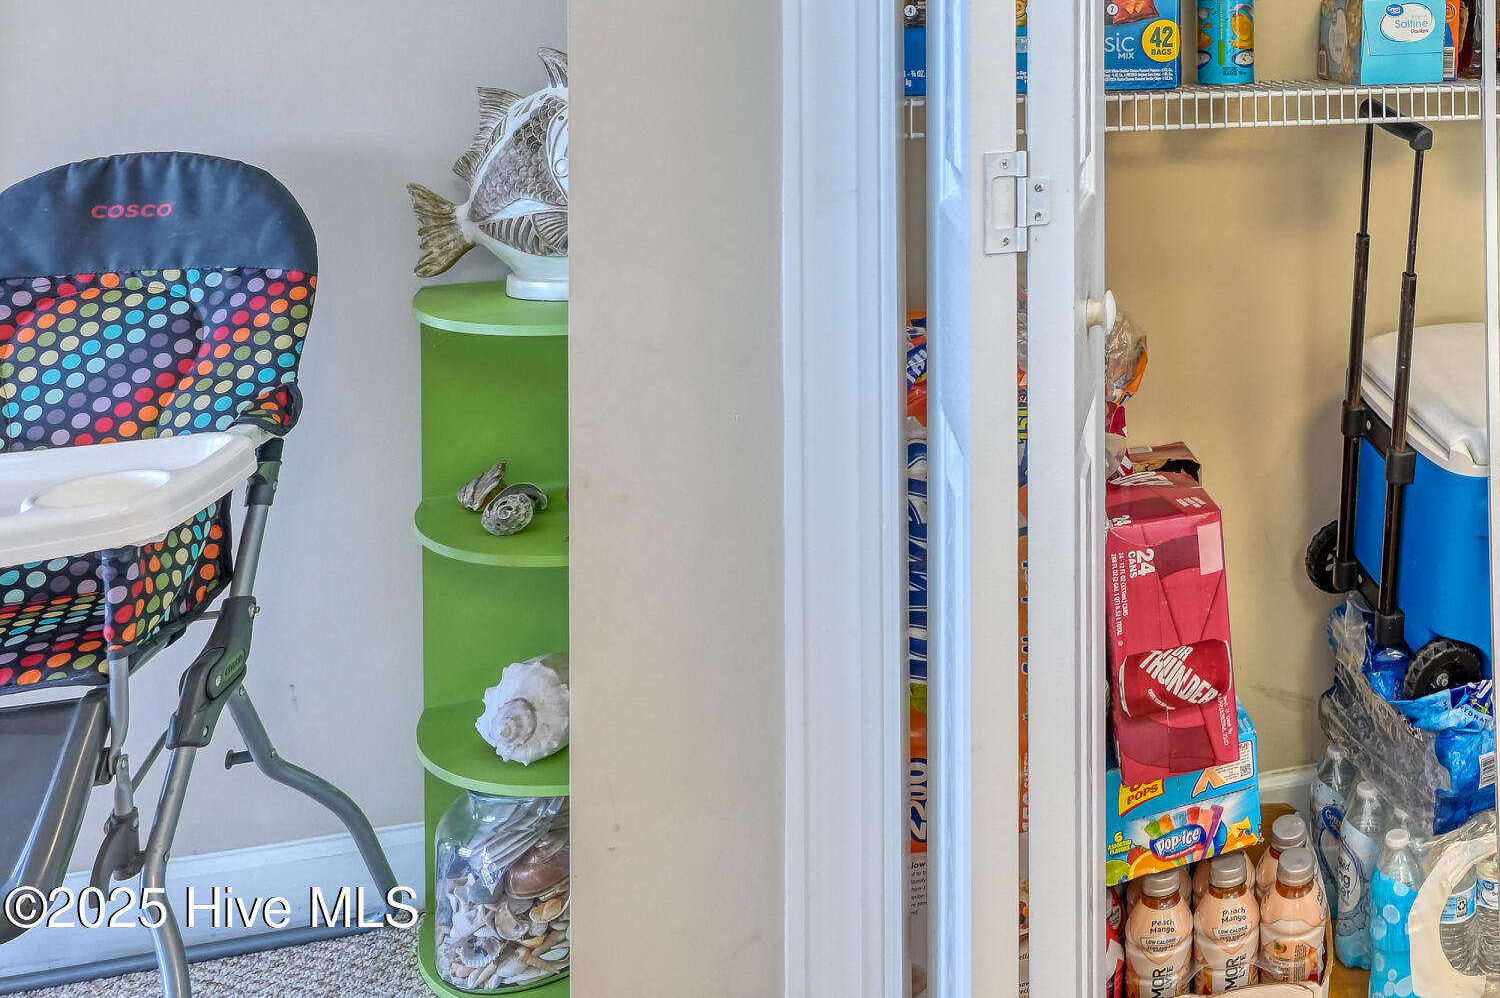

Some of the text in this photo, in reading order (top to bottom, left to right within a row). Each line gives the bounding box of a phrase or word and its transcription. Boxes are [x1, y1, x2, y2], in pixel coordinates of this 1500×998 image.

[1395, 19, 1428, 29] Saltine
[1104, 32, 1134, 52] sic
[1150, 26, 1173, 47] 42
[91, 203, 172, 218] COSCO
[1128, 551, 1137, 579] CANS
[1136, 548, 1156, 579] 24
[1172, 646, 1193, 661] DR
[1140, 650, 1219, 704] THUNDER
[1127, 783, 1159, 805] POPS
[1114, 832, 1123, 842] 6
[1108, 840, 1132, 850] ASSORTED
[1109, 846, 1130, 855] FLAVORS
[1222, 907, 1245, 917] Peach
[1152, 919, 1175, 927] Peach
[1222, 915, 1246, 925] Mango
[1229, 925, 1248, 934] CALORIE
[1156, 937, 1176, 945] CALORIE
[1224, 956, 1239, 992] MOR
[1152, 968, 1166, 998] MOR
